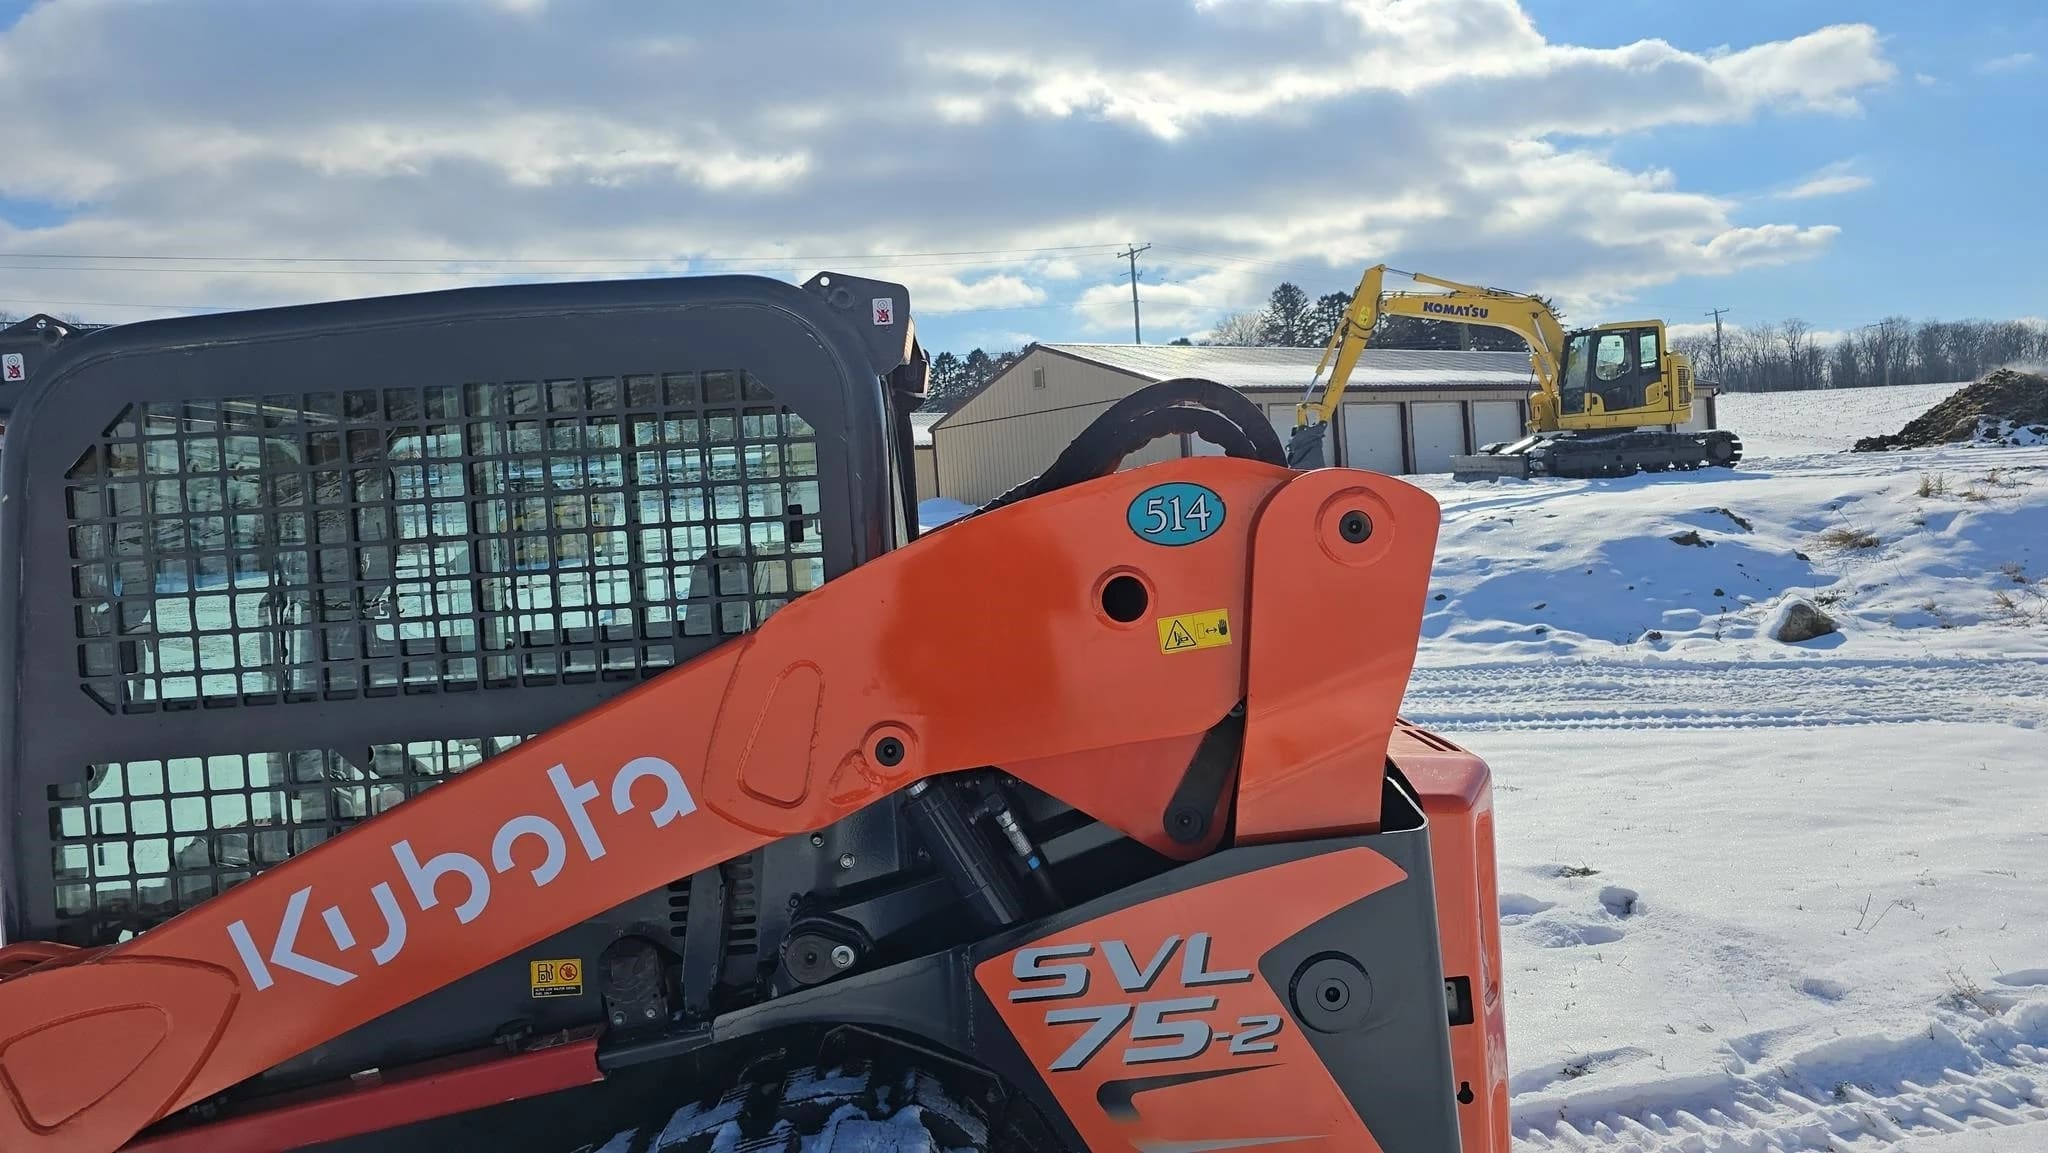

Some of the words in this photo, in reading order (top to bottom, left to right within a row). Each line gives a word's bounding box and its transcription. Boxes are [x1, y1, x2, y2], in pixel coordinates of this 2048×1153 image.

[1424, 302, 1489, 318] KOMATSU
[1143, 493, 1212, 534] 514
[226, 756, 697, 992] Kubota
[1009, 932, 1254, 1003] SVL
[1045, 997, 1282, 1072] 75-2
